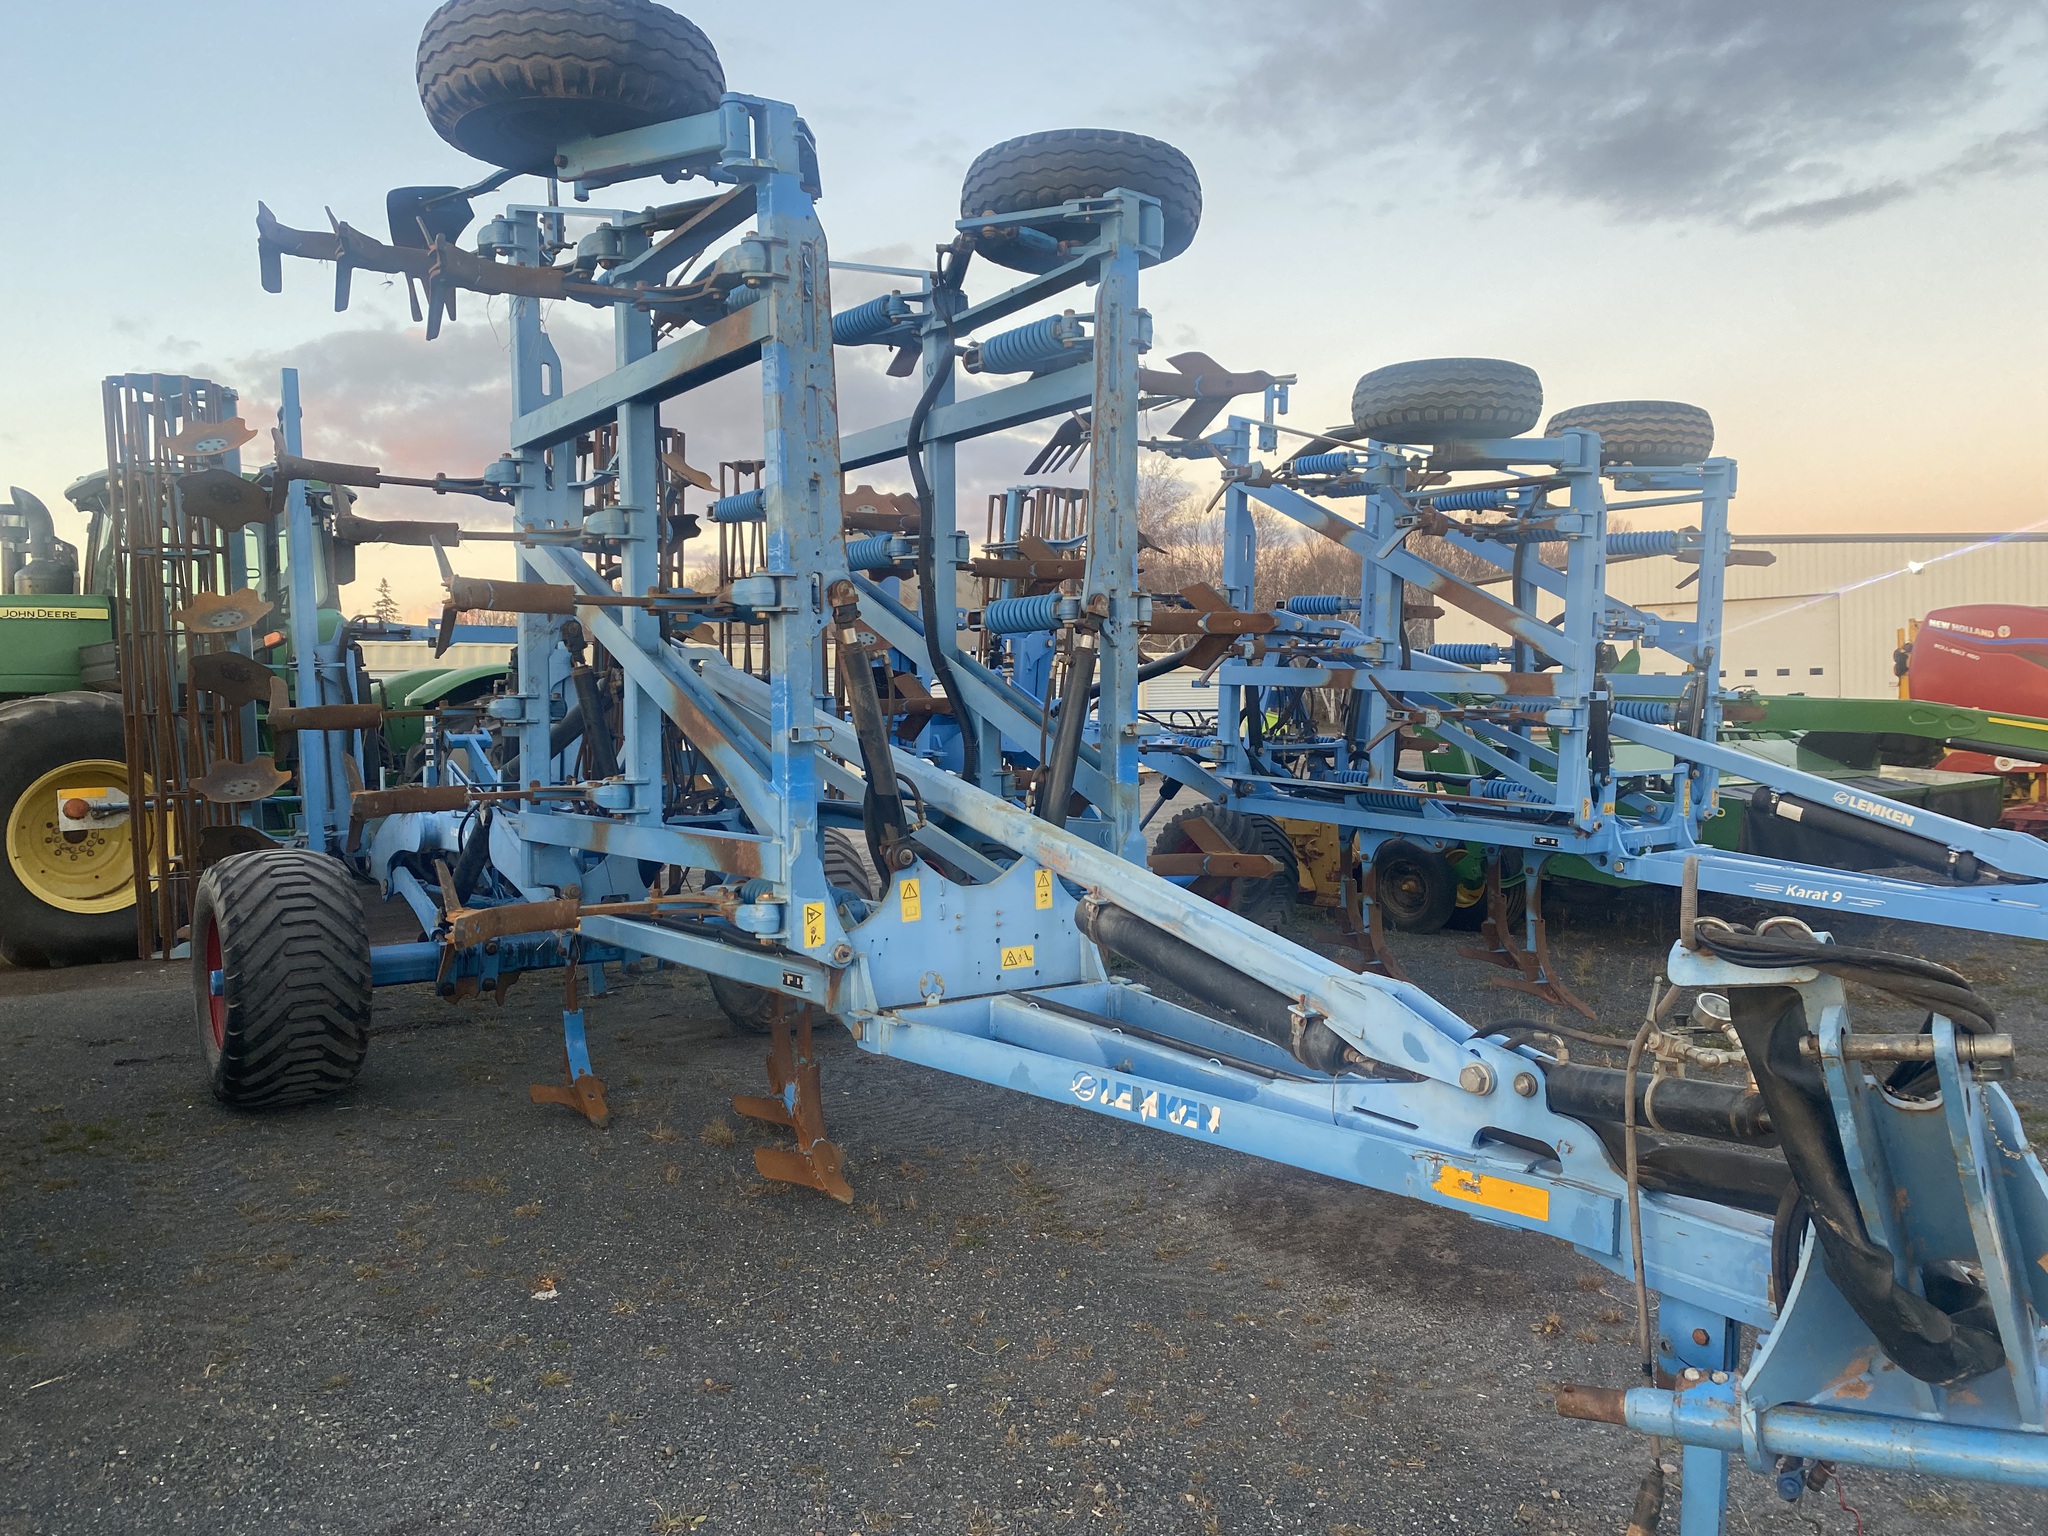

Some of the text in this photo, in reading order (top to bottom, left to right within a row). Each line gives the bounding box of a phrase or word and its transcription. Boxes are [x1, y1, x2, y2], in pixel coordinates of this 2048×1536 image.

[3, 609, 77, 618] JOHN DEERE
[1929, 619, 1995, 638] NEW HOLLAND
[1848, 795, 1915, 827] LEMKEN
[1785, 884, 1842, 902] Karat 9
[1100, 1078, 1220, 1134] LEMKEN
